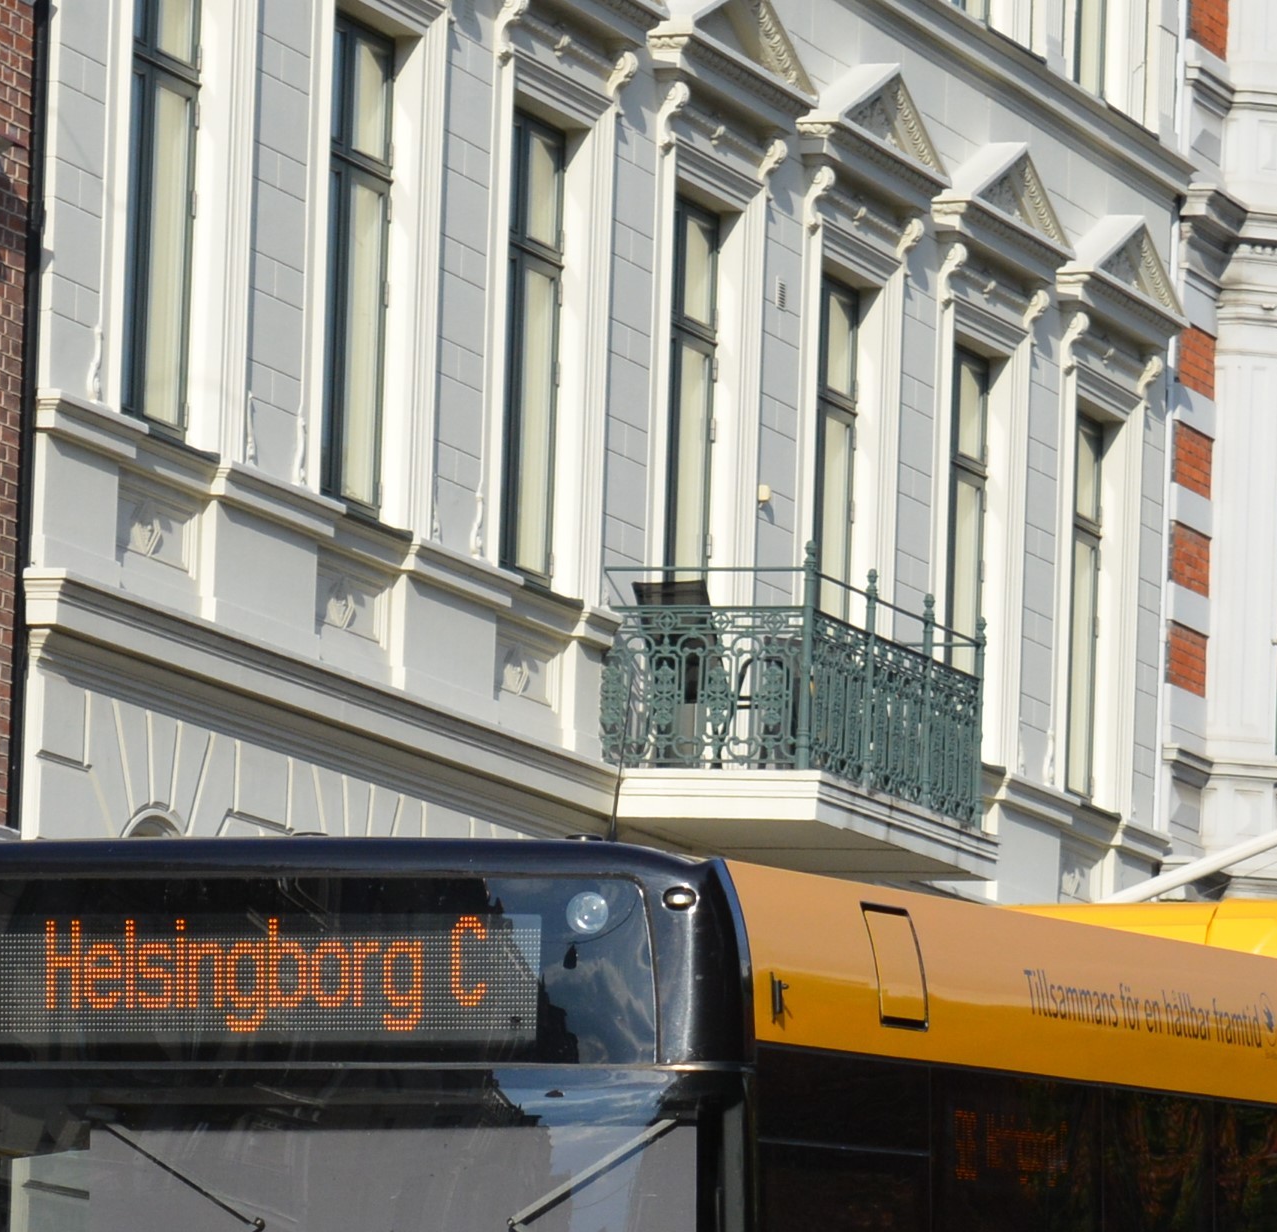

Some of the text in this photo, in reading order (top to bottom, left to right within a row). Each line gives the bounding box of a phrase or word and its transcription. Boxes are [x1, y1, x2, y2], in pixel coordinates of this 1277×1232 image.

[43, 917, 424, 1033] Helsingborg
[449, 915, 487, 1007] C
[1023, 968, 1262, 1049] Tillsammans för en hållbar framtid
